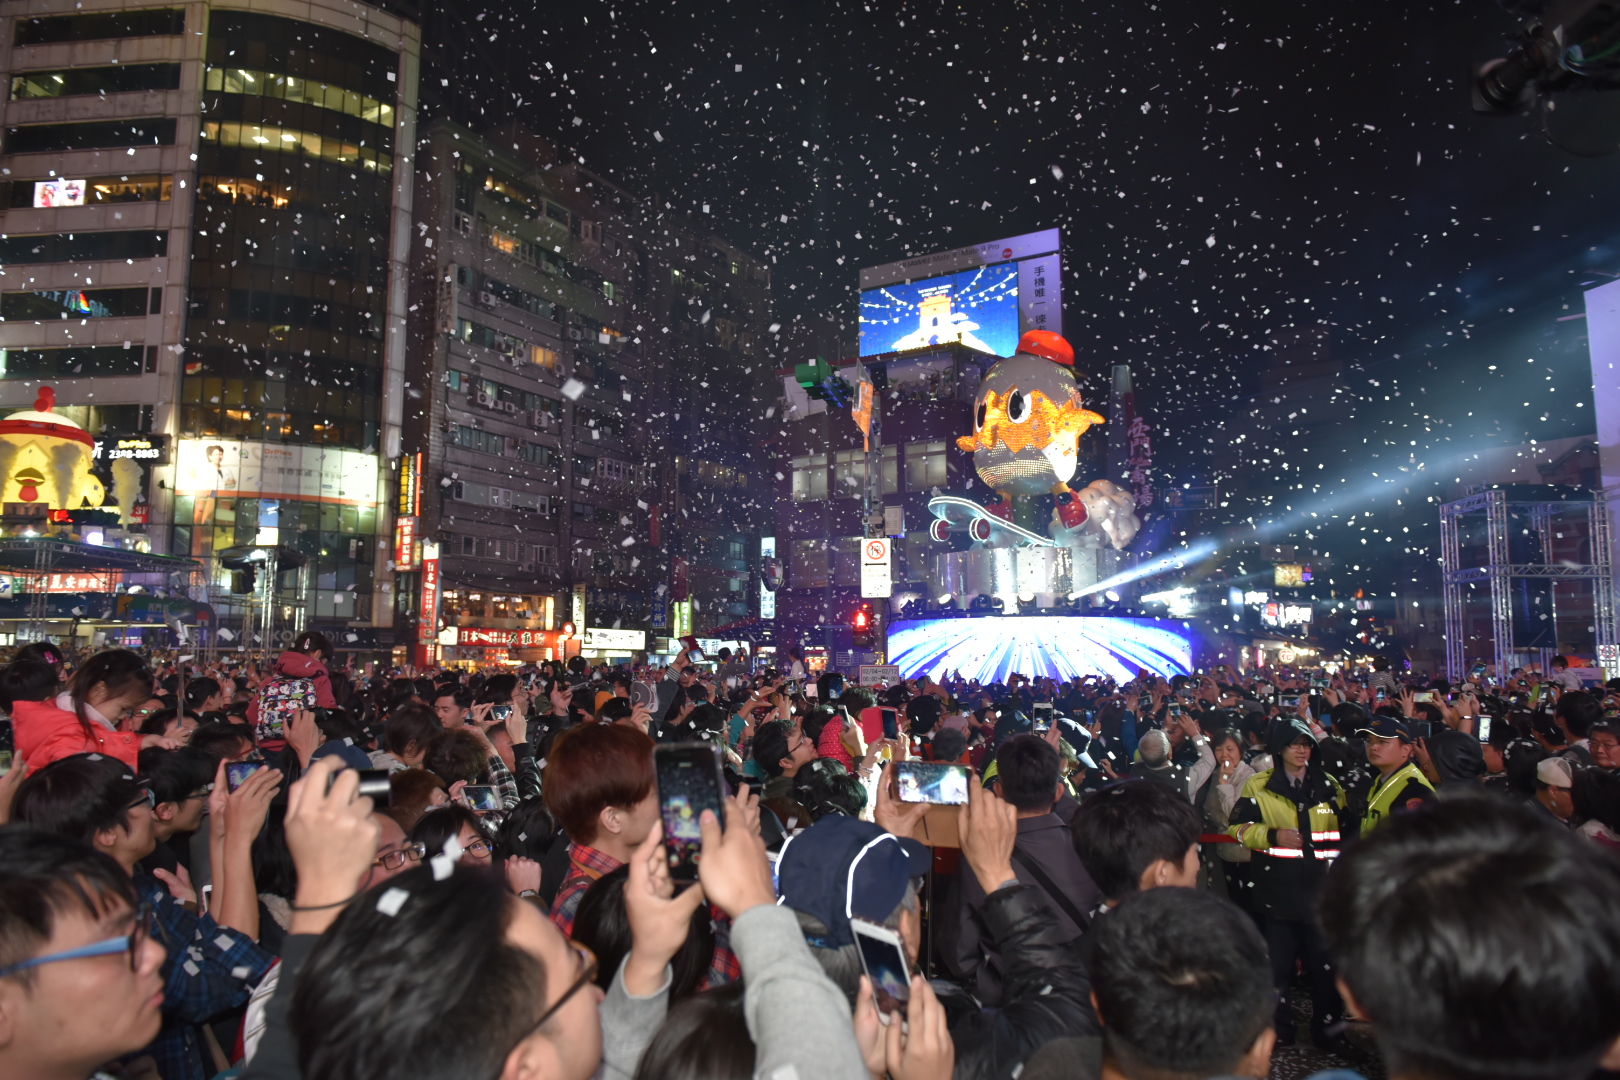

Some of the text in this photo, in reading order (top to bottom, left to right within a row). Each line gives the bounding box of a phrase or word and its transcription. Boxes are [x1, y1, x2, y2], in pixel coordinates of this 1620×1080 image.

[933, 253, 951, 263] Mate
[961, 247, 980, 257] Mate
[987, 243, 1000, 251] Pro
[1034, 265, 1046, 305] 手機唯一
[264, 448, 293, 456] DrPlus
[461, 630, 479, 643] 日本
